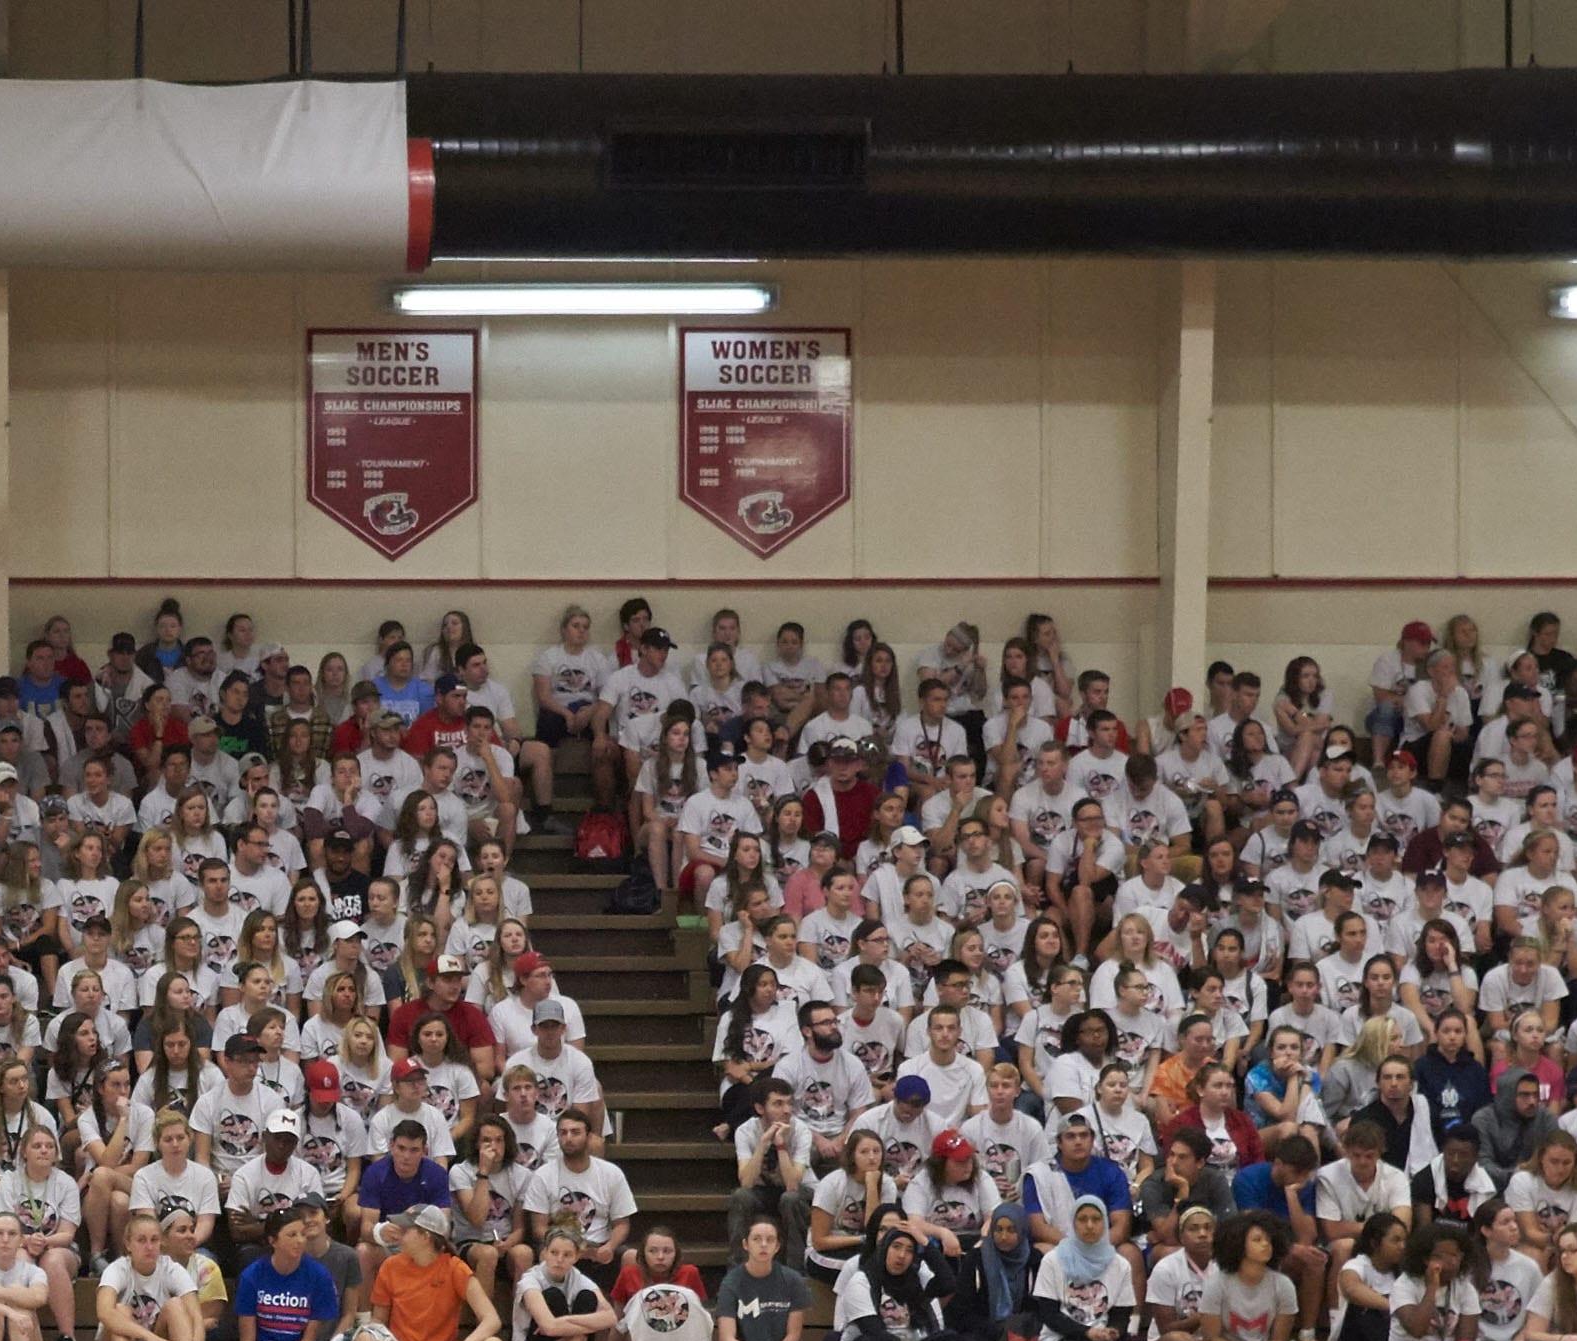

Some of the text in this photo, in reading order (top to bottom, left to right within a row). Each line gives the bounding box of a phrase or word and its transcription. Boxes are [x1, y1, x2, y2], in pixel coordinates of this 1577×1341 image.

[356, 342, 429, 362] MEN'S
[711, 340, 820, 360] WOMEN'S
[346, 366, 439, 386] SOCCER
[719, 365, 812, 384] SOCCER
[324, 400, 461, 412] SLIAC CHAMPIONSHIPS
[697, 398, 832, 410] SLIAC CHAMPIONSHI
[373, 417, 412, 426] LEAGUE
[361, 460, 426, 468] TOURNAMENT
